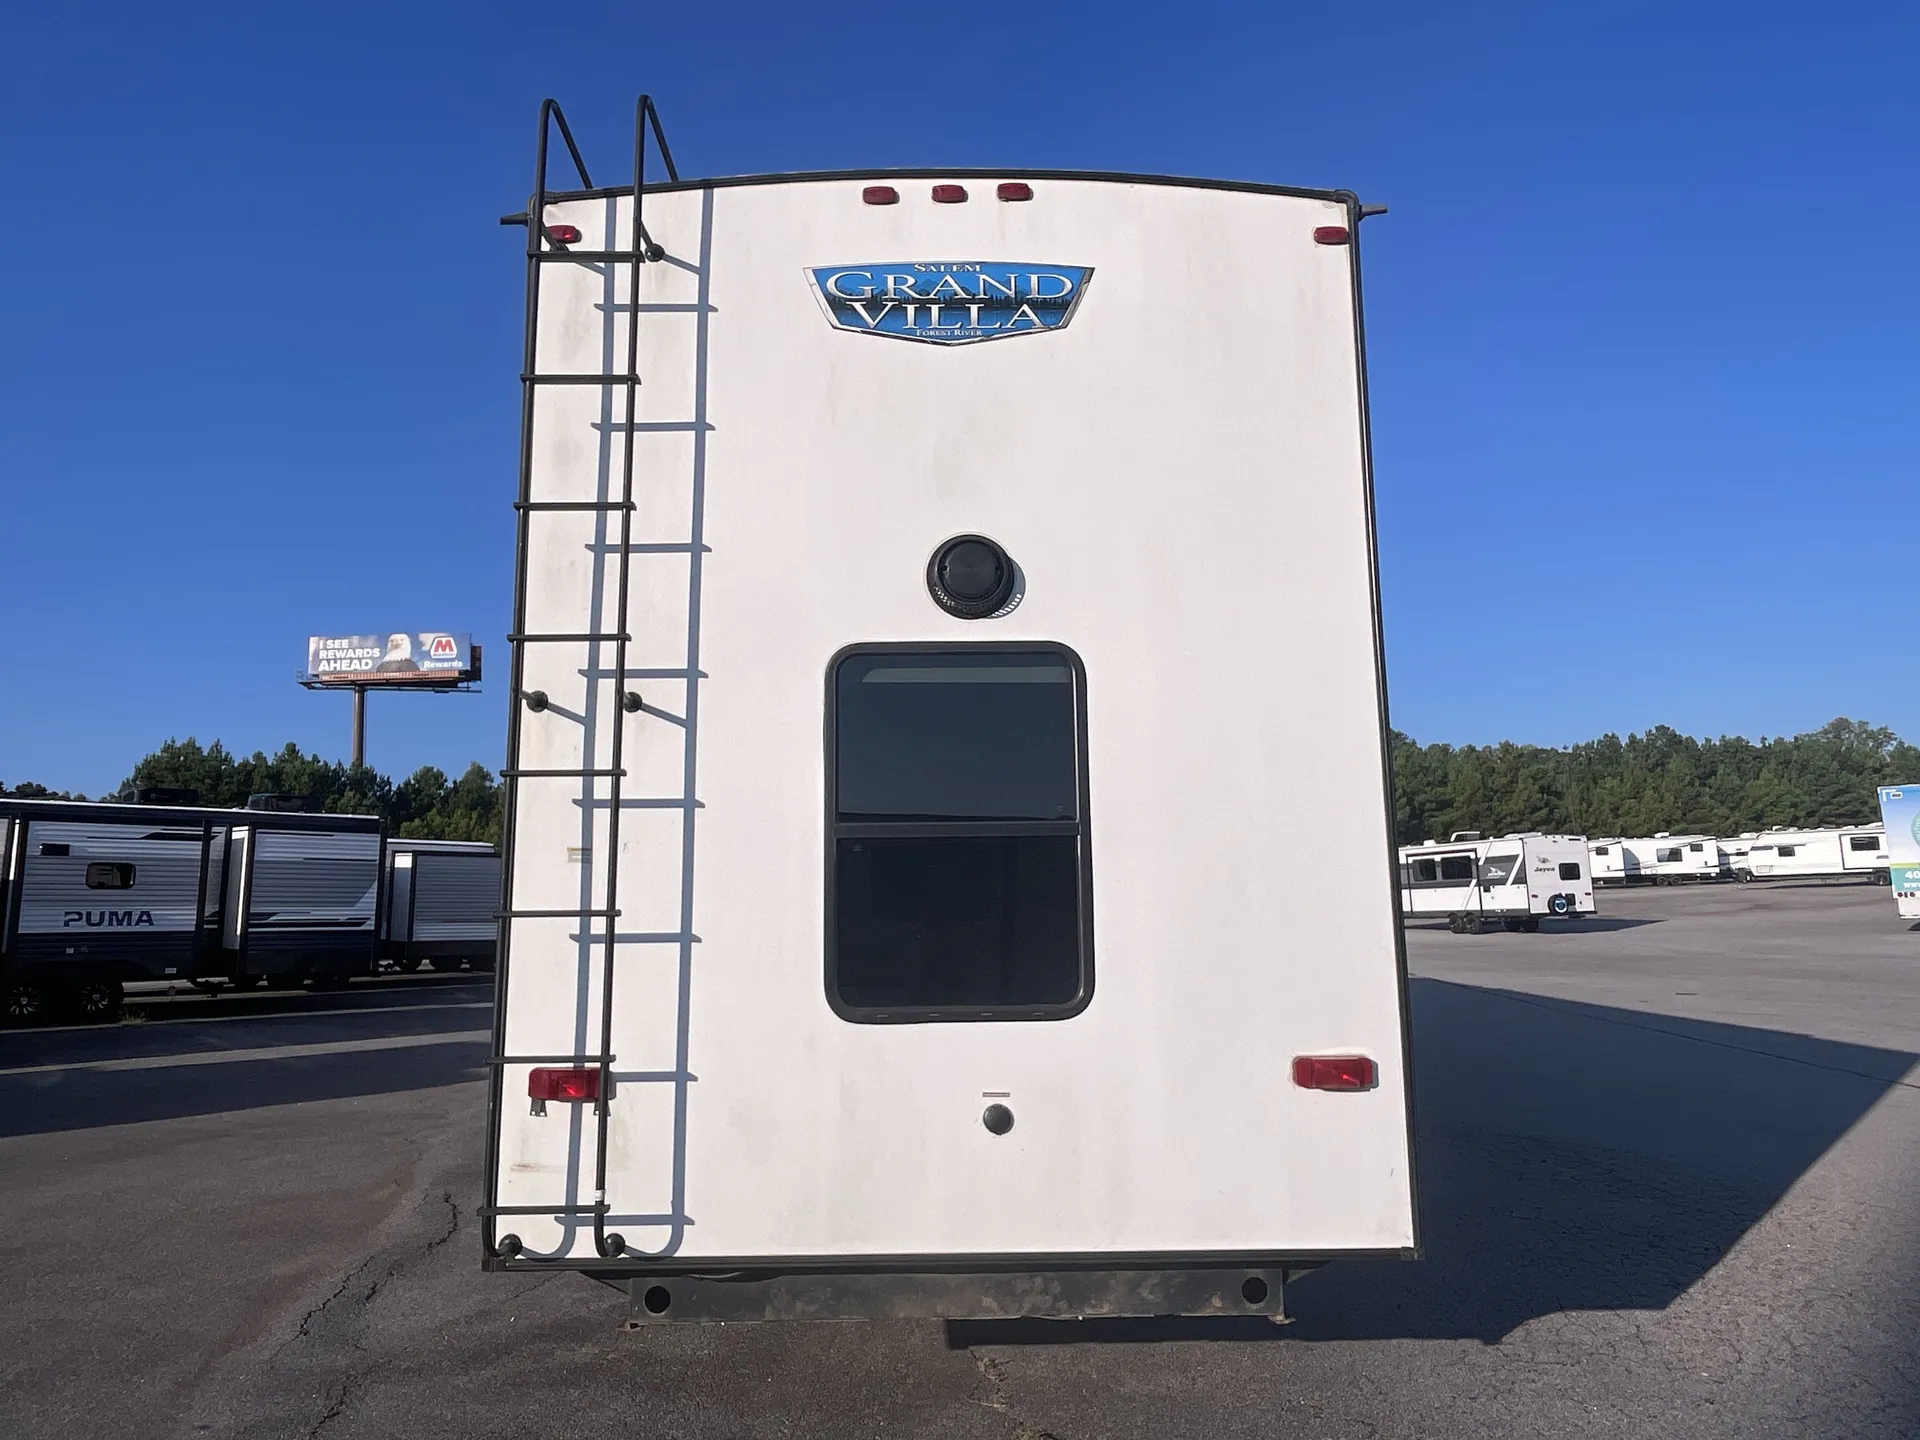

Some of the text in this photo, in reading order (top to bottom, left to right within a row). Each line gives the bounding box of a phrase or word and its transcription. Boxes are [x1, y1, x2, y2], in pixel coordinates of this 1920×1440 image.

[914, 264, 981, 272] SALEM
[826, 272, 1073, 299] GRAND
[845, 301, 1045, 329] VILLA
[319, 639, 348, 648] I SEE
[319, 648, 381, 660] REWARDS
[318, 660, 373, 672] AHEAD
[423, 660, 463, 669] Rewards
[63, 910, 154, 928] PUMA
